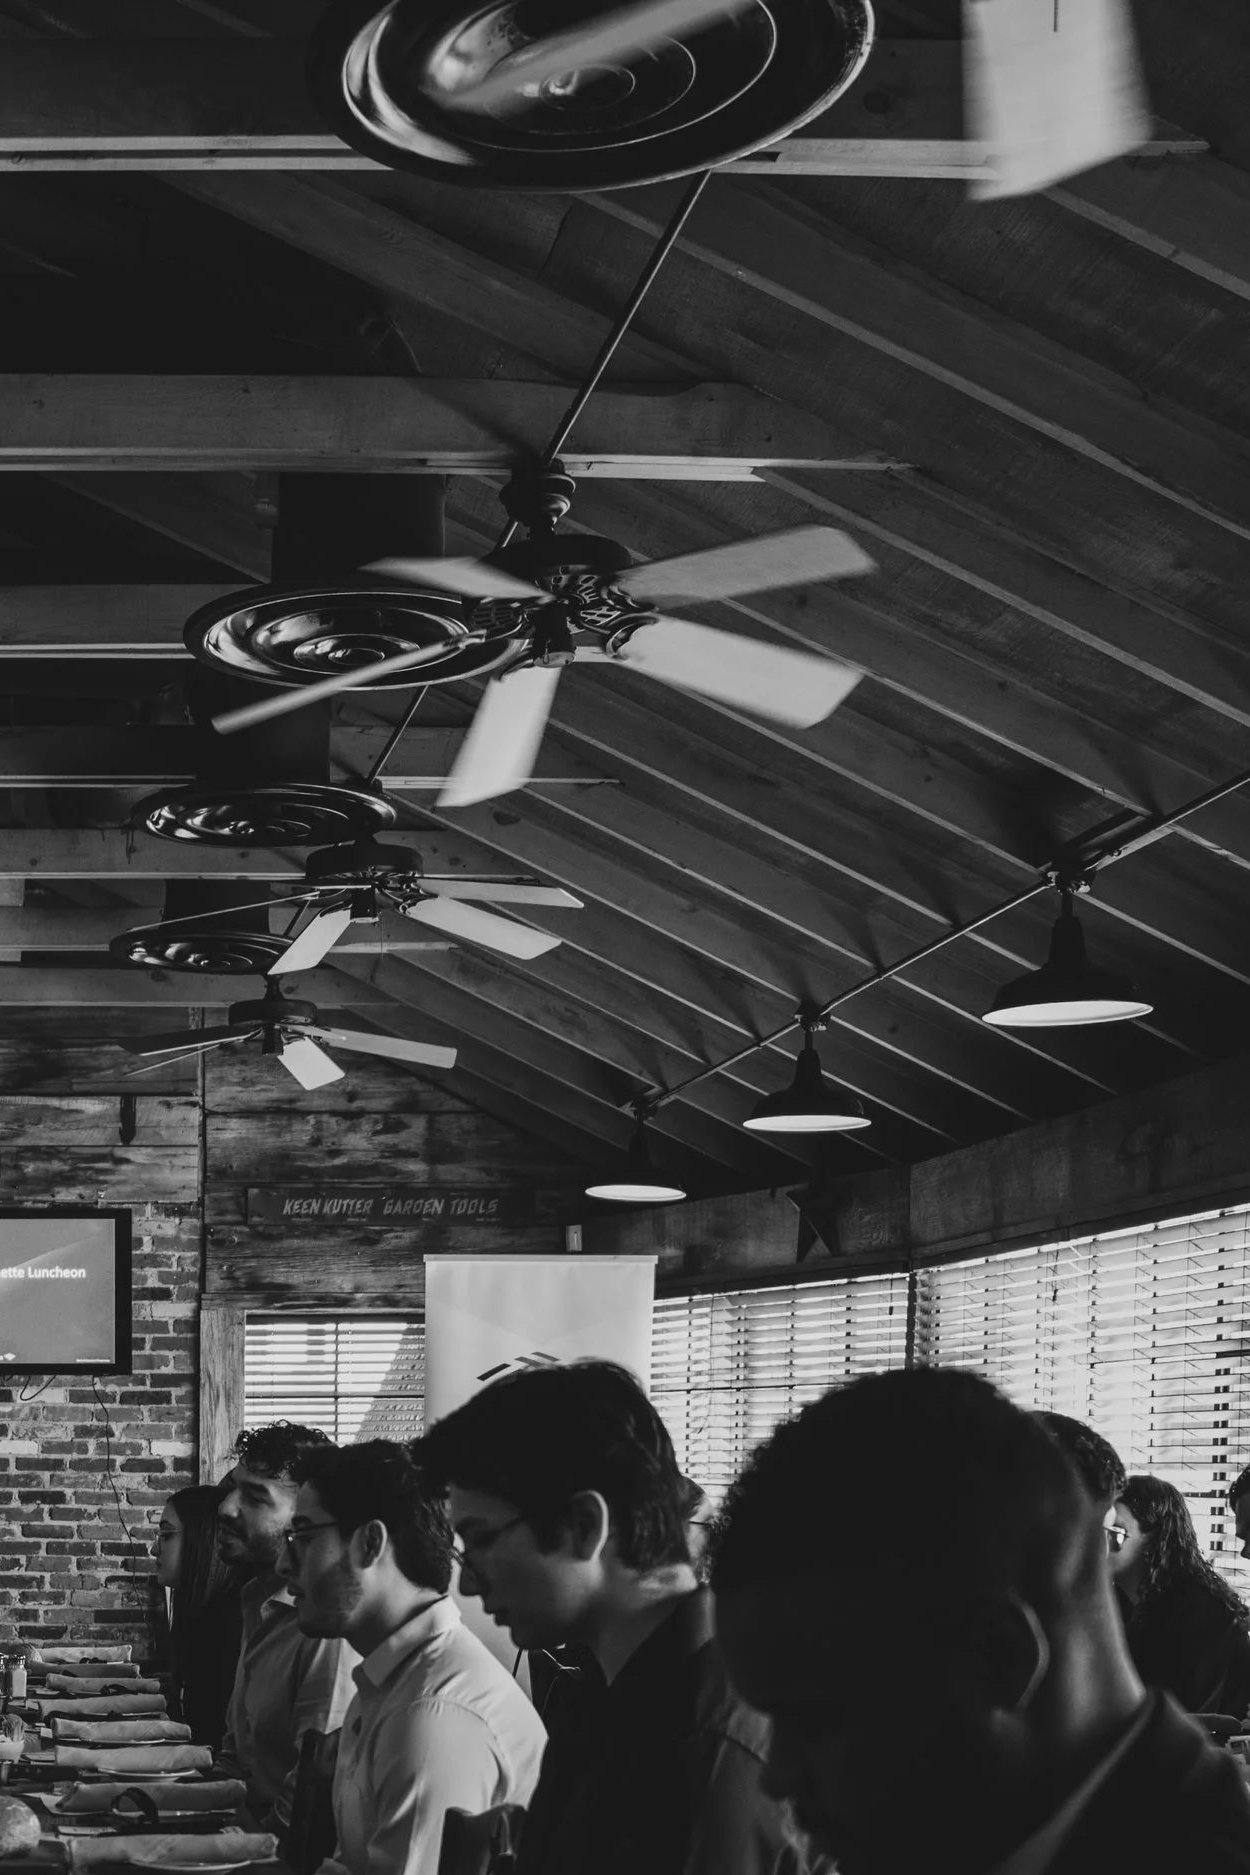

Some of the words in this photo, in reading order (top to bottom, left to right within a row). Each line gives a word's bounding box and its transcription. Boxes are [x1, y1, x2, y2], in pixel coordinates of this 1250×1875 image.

[282, 1198, 321, 1216] KEEN
[321, 1198, 374, 1216] KUTTER
[383, 1198, 444, 1216] GARDEN
[450, 1198, 499, 1215] TOOLS
[28, 1266, 86, 1279] Luncheon
